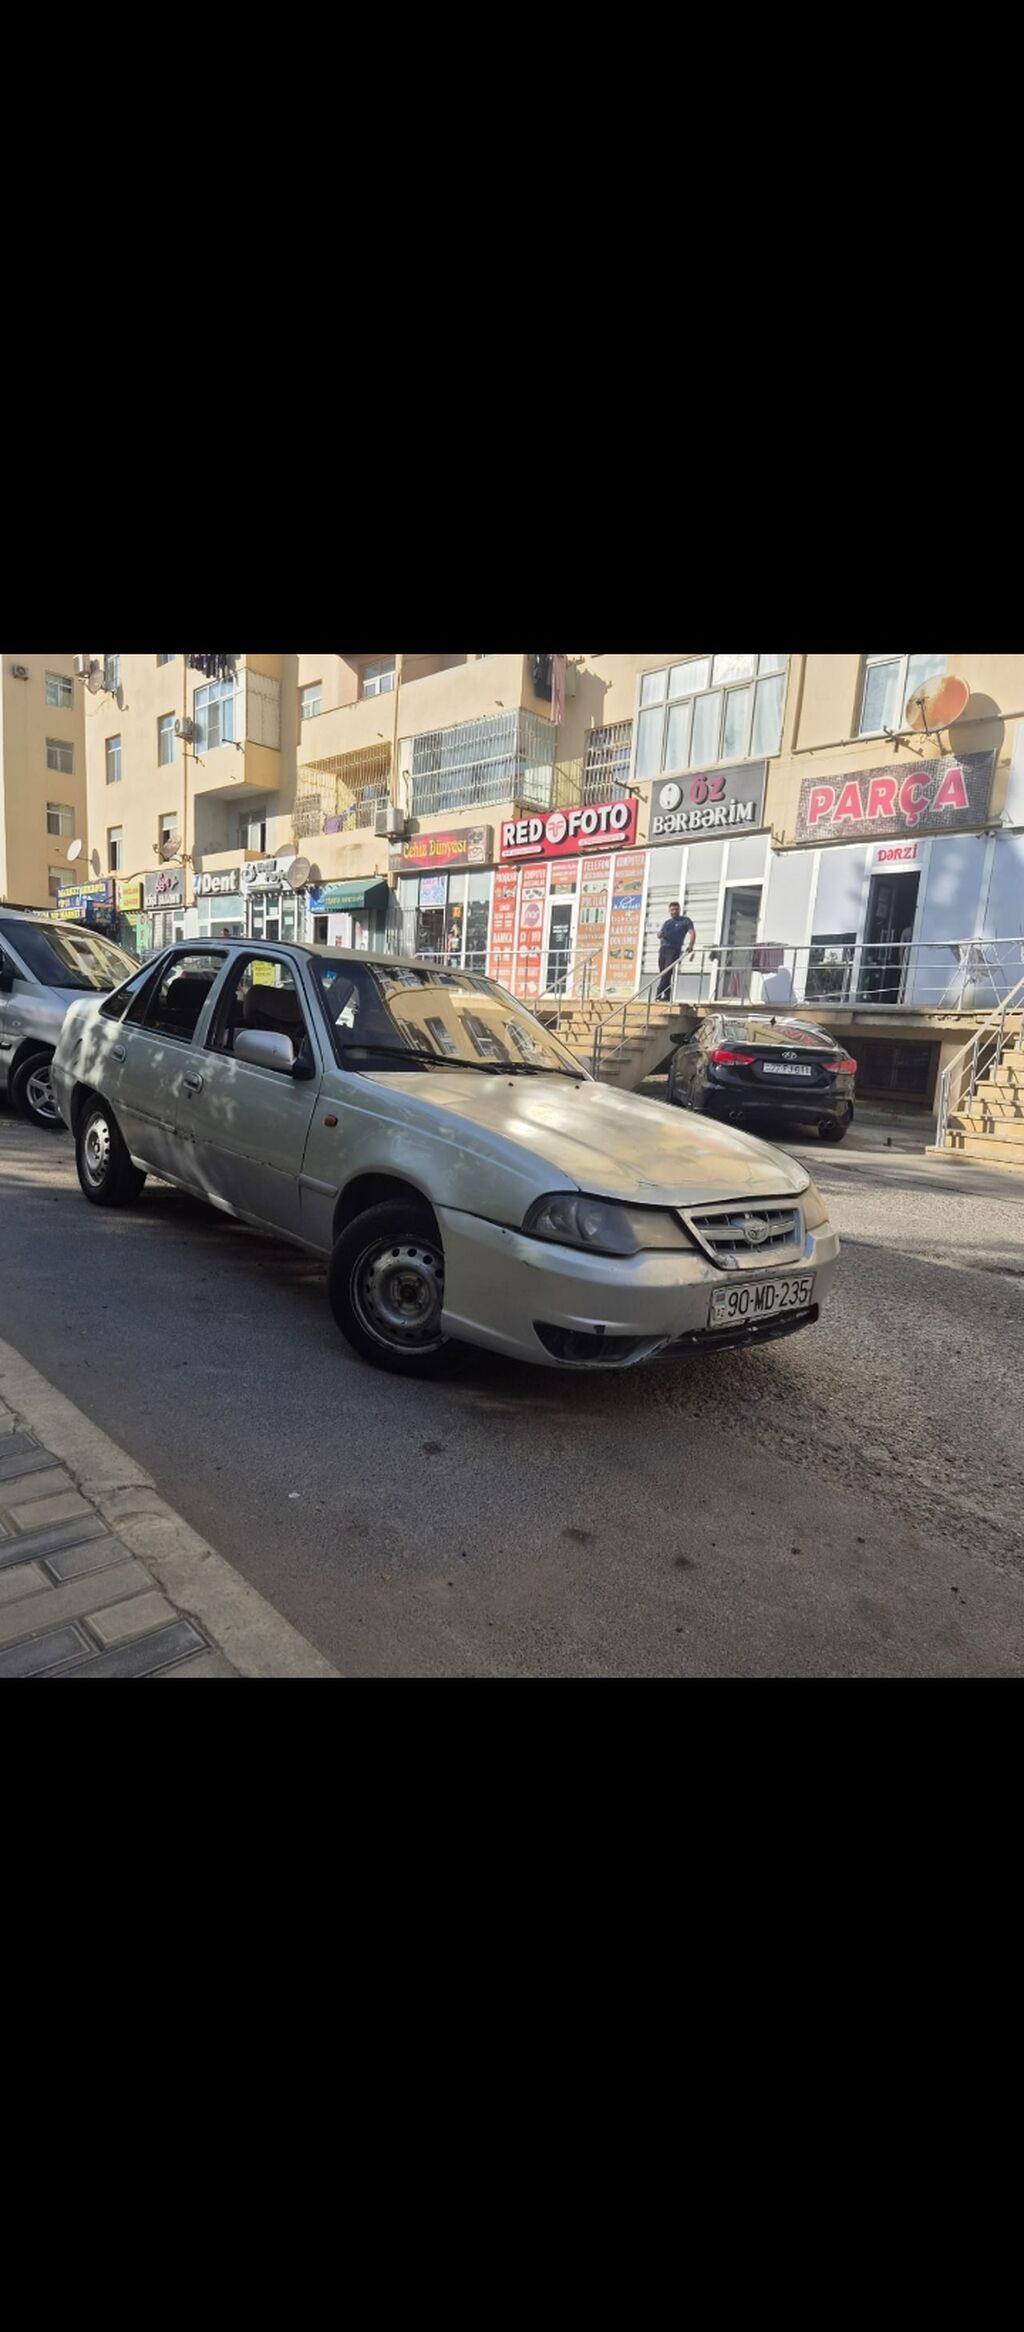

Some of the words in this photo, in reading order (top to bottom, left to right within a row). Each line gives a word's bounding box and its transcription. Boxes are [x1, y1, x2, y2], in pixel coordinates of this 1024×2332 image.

[688, 774, 727, 805] ÖZ
[805, 767, 971, 827] PARÇA
[503, 818, 543, 847] RED
[568, 803, 630, 838] FOTO
[652, 799, 757, 835] BƏRBƏRİM
[877, 843, 918, 862] DƏRZİ
[202, 872, 237, 893] Dent
[728, 1280, 809, 1316] 90-MD-235
